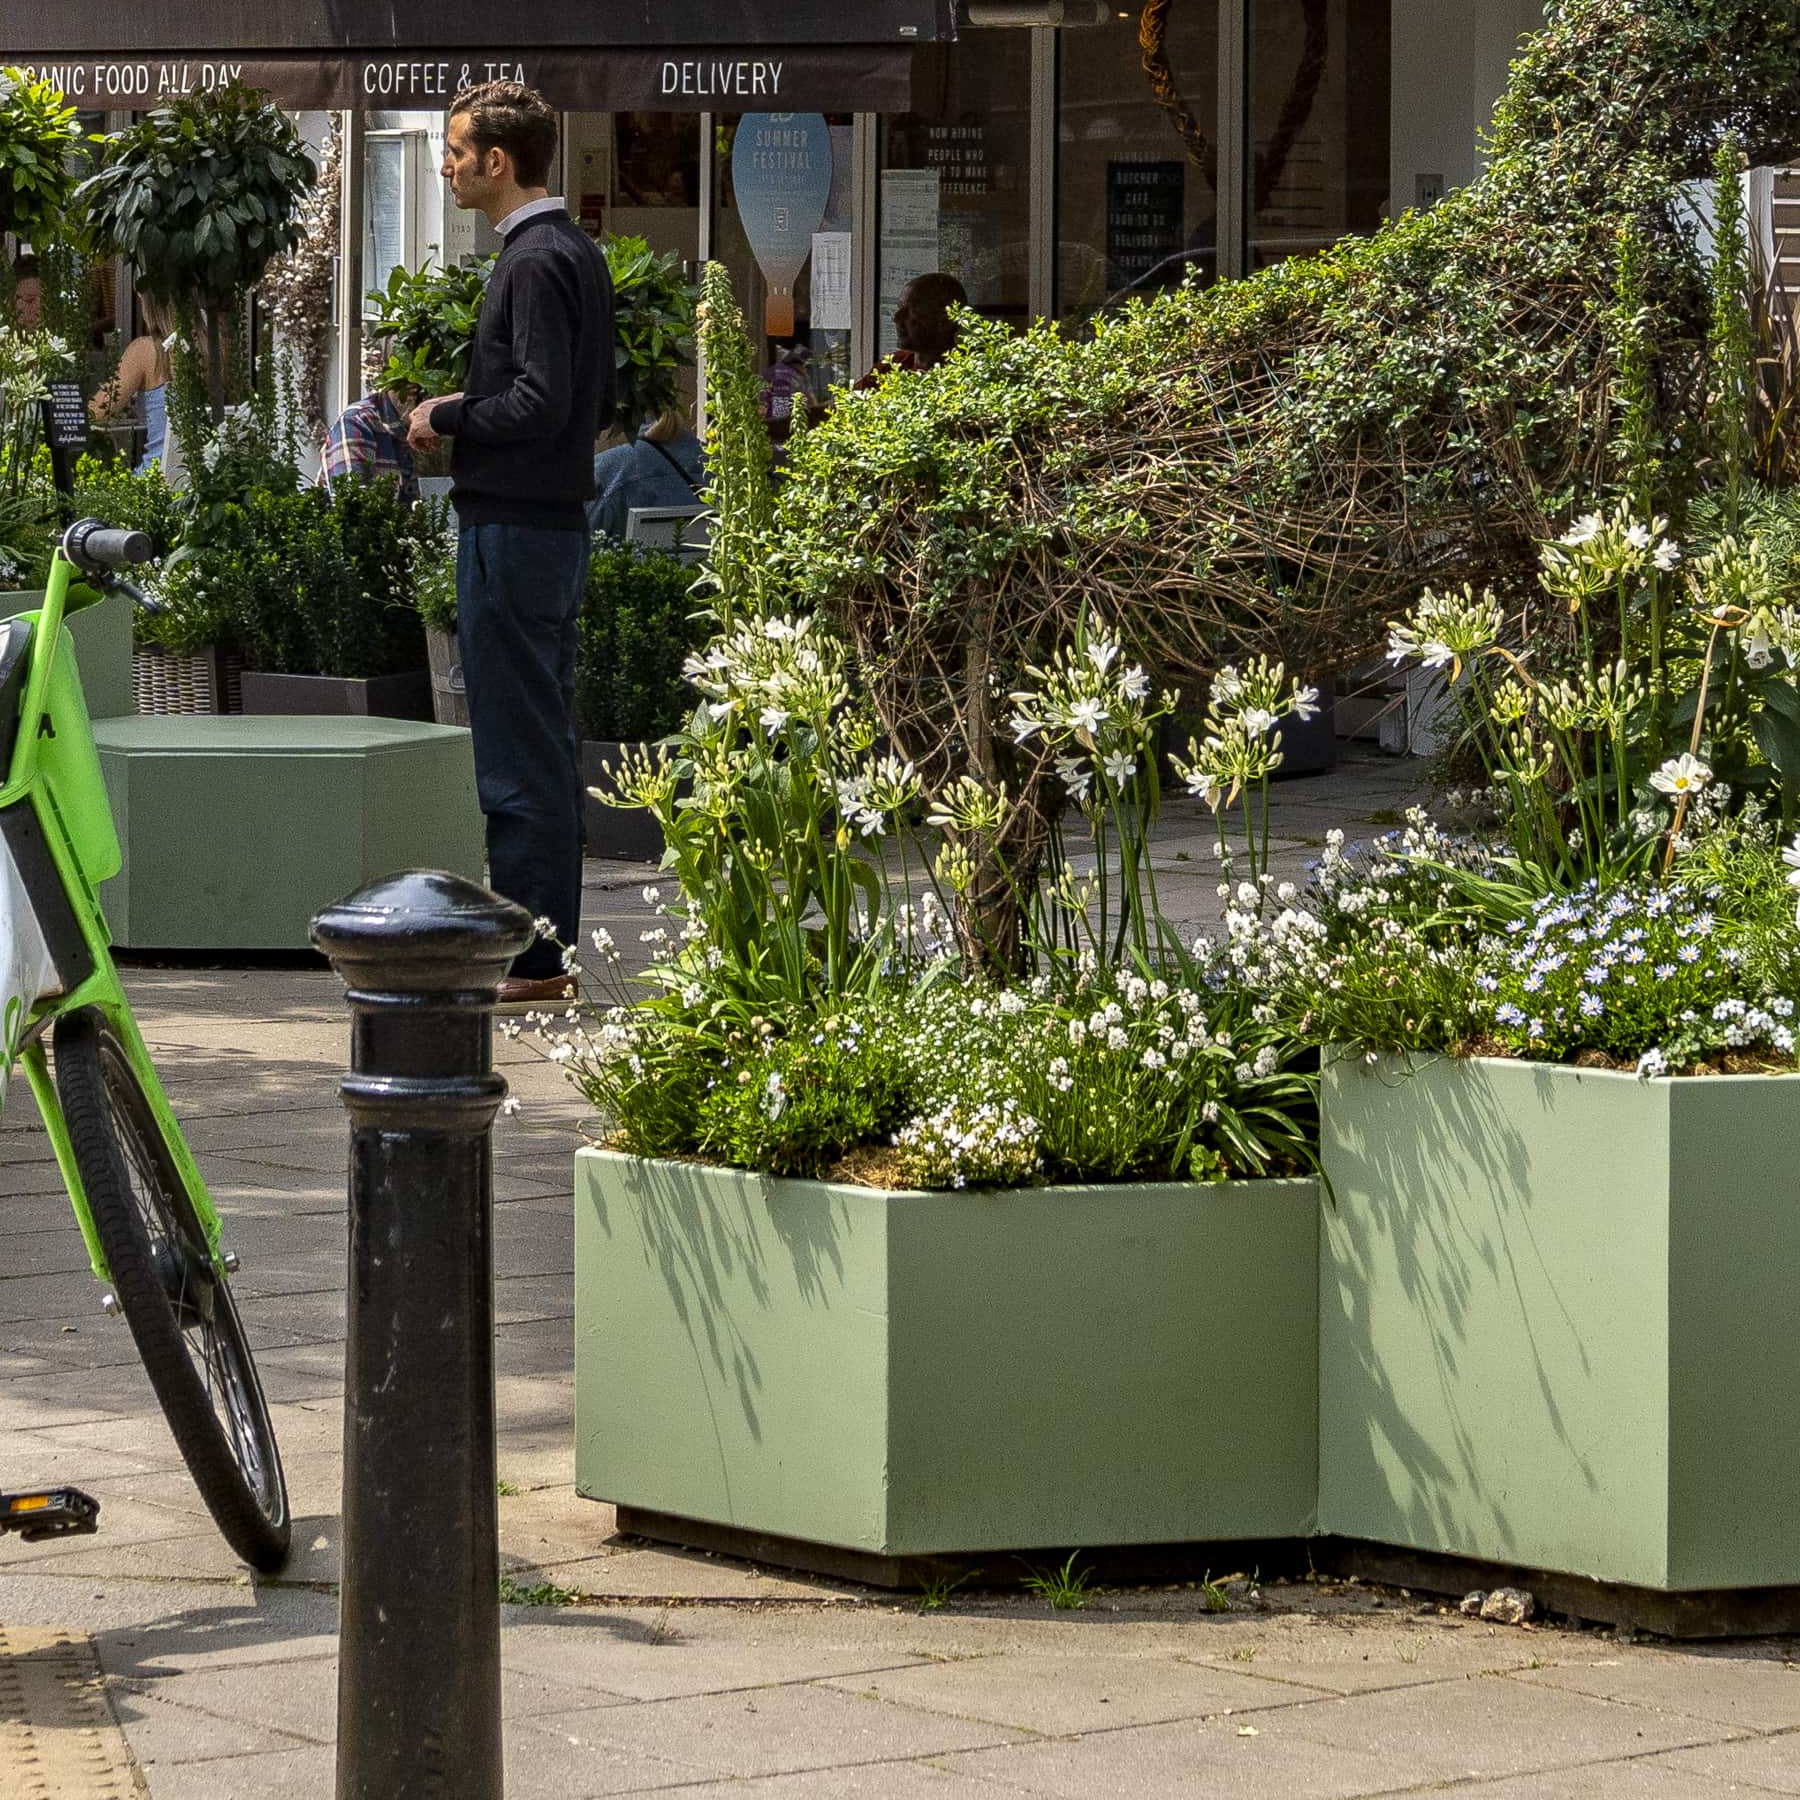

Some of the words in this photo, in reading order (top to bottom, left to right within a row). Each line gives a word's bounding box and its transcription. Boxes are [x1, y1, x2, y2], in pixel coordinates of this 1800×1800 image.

[95, 64, 149, 95] FOOD
[158, 64, 192, 94] ALL
[202, 64, 242, 92] DAY
[364, 63, 449, 94] COFFEE
[457, 63, 471, 92] &
[484, 63, 526, 87] TEA
[662, 62, 782, 94] DELIVERY
[755, 130, 809, 148] SUMMER
[753, 151, 811, 169] FESTIVAL
[928, 149, 961, 161] PEOPLE
[943, 183, 987, 195] FFERENCE
